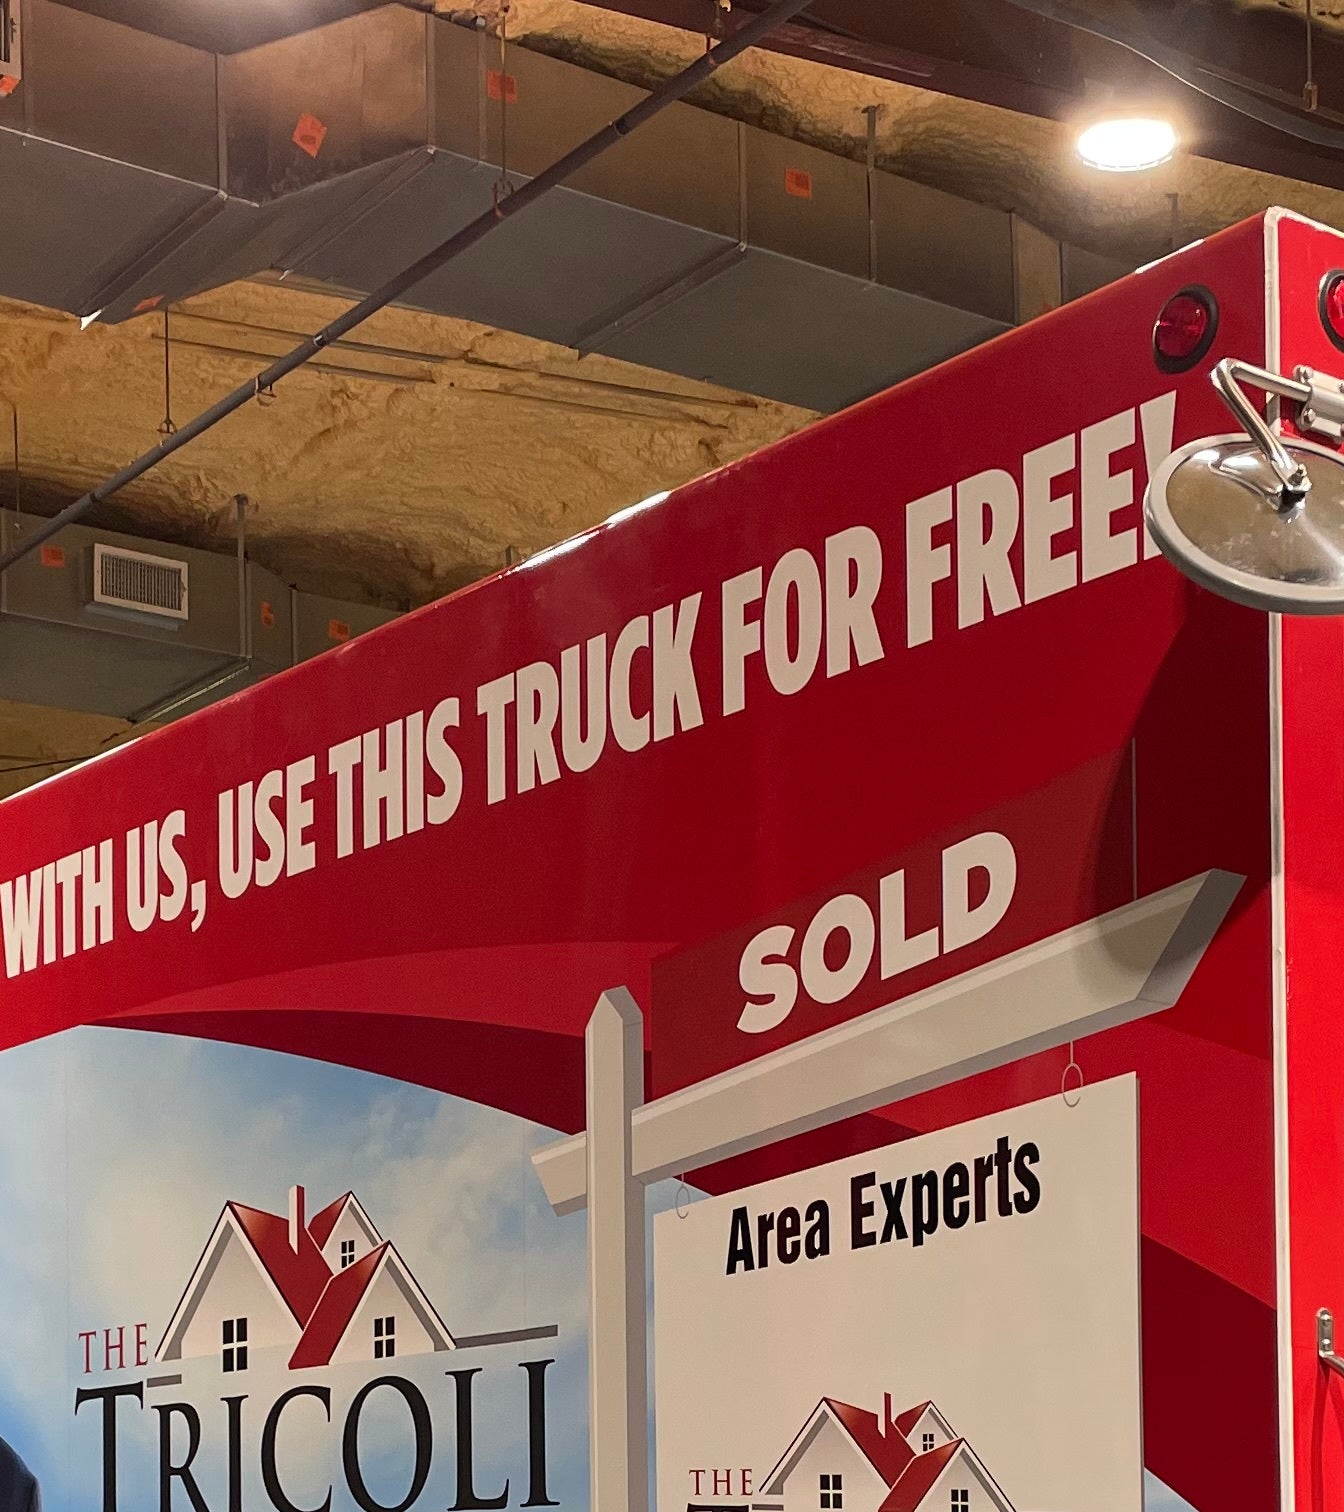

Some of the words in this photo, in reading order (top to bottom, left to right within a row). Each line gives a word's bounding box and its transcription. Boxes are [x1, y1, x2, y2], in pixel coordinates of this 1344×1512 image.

[0, 838, 114, 979] WITH
[126, 809, 207, 933] US,
[219, 755, 316, 899] USE
[329, 696, 463, 859] THIS
[476, 591, 705, 805] TRUCK
[722, 524, 884, 717] FOR
[905, 389, 1178, 649] FREE!
[736, 831, 1017, 1034] SOLD
[725, 1199, 831, 1275] Area
[850, 1135, 1041, 1250] Experts
[78, 1323, 148, 1373] THE
[688, 1467, 754, 1497] THE
